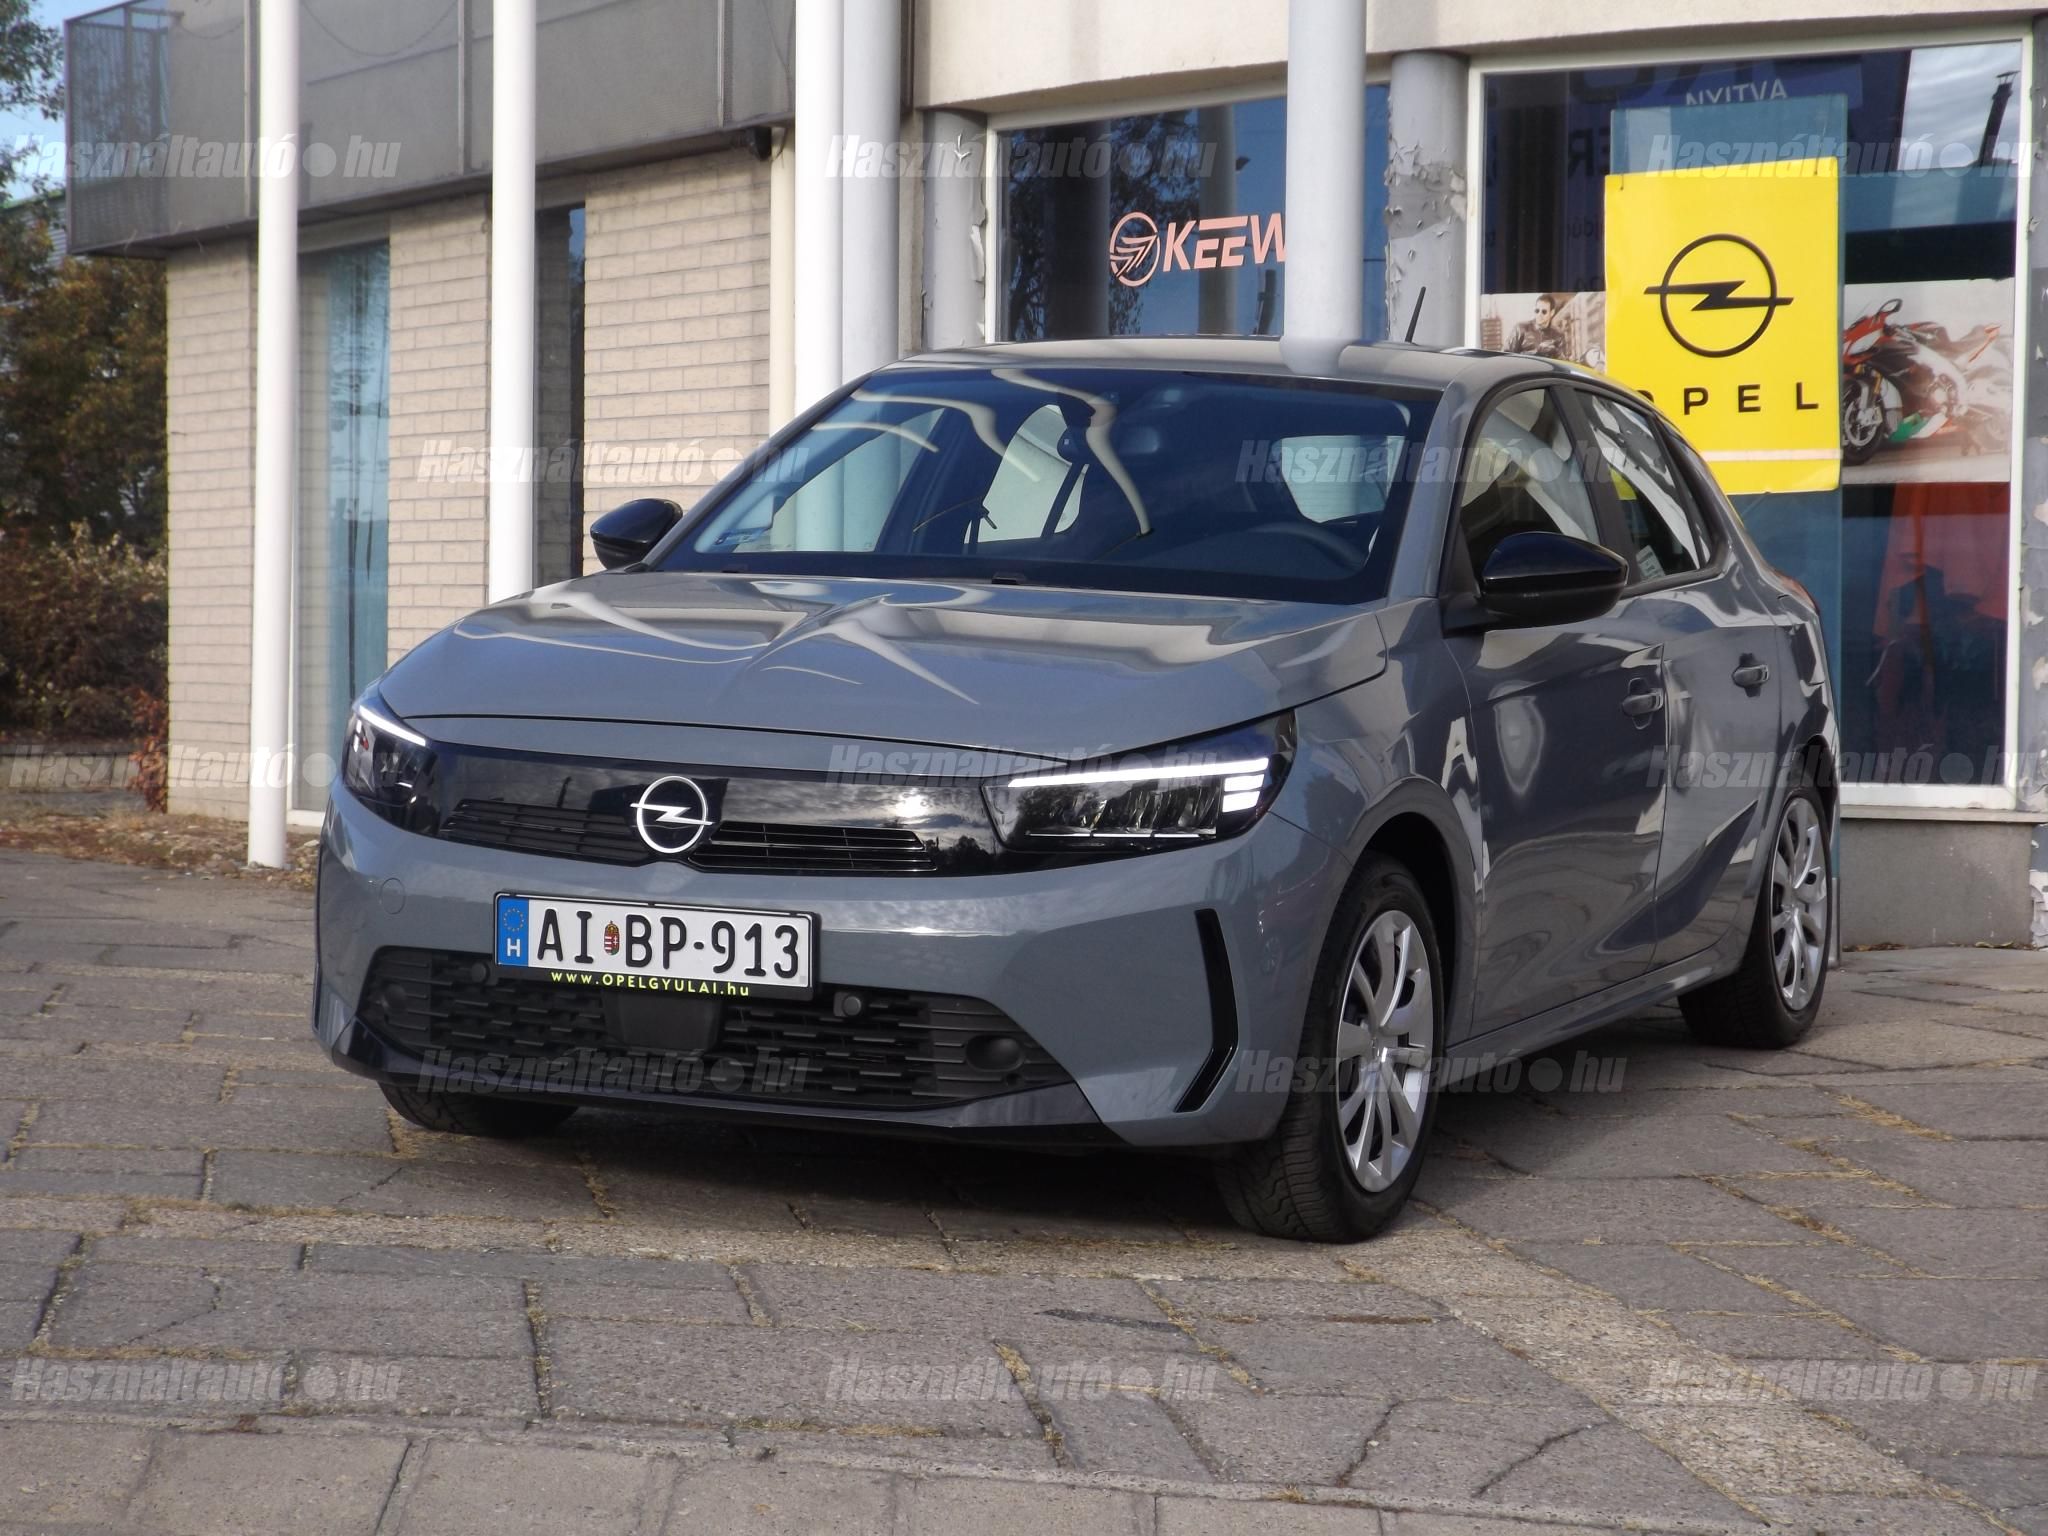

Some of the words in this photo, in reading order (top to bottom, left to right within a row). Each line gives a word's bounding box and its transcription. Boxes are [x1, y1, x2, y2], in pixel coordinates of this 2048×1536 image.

[1163, 212, 1287, 272] KEEW
[1636, 382, 1819, 416] PEL
[506, 937, 521, 958] H
[551, 971, 751, 997] www.OPELGYULAI.hu
